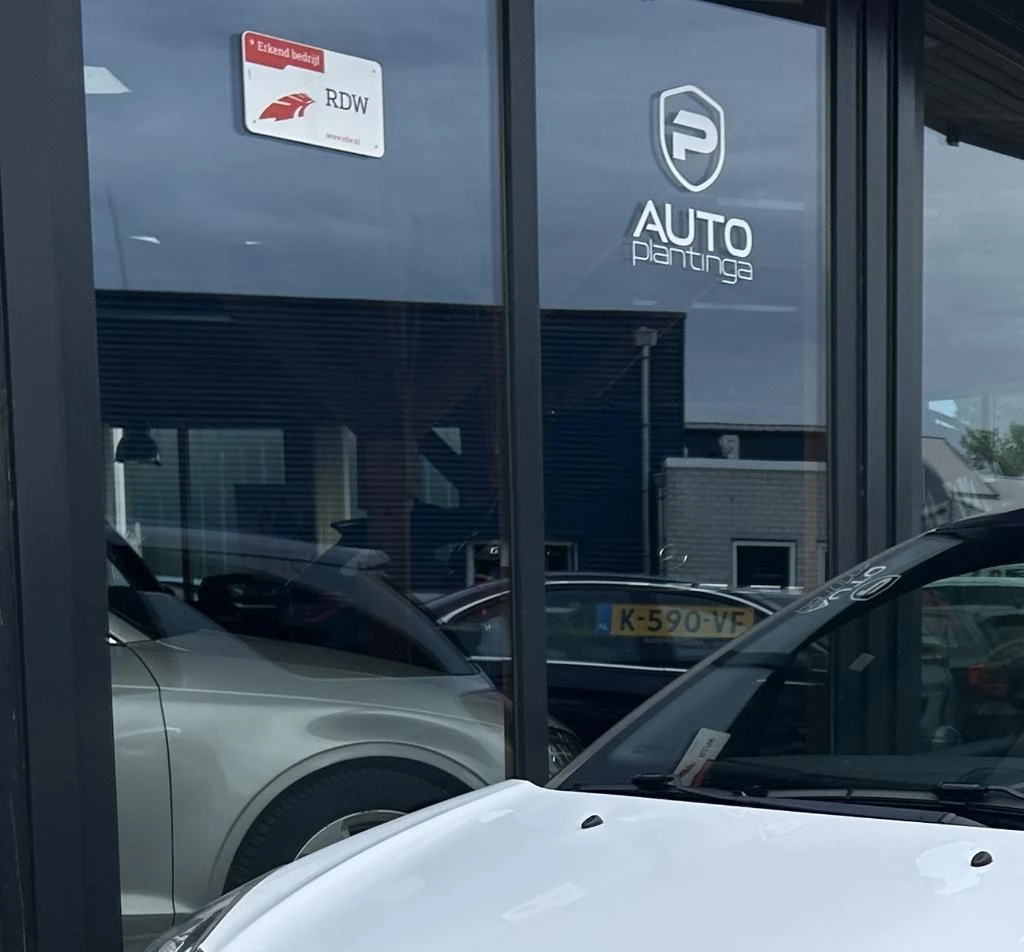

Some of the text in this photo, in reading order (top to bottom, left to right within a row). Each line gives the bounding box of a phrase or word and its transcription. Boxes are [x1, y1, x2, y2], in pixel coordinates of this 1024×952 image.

[257, 41, 320, 66] Erkend bedrijf
[325, 88, 369, 114] RDW
[632, 199, 753, 258] AUTO
[632, 238, 753, 285] plantinga
[619, 608, 745, 633] K-590-VF
